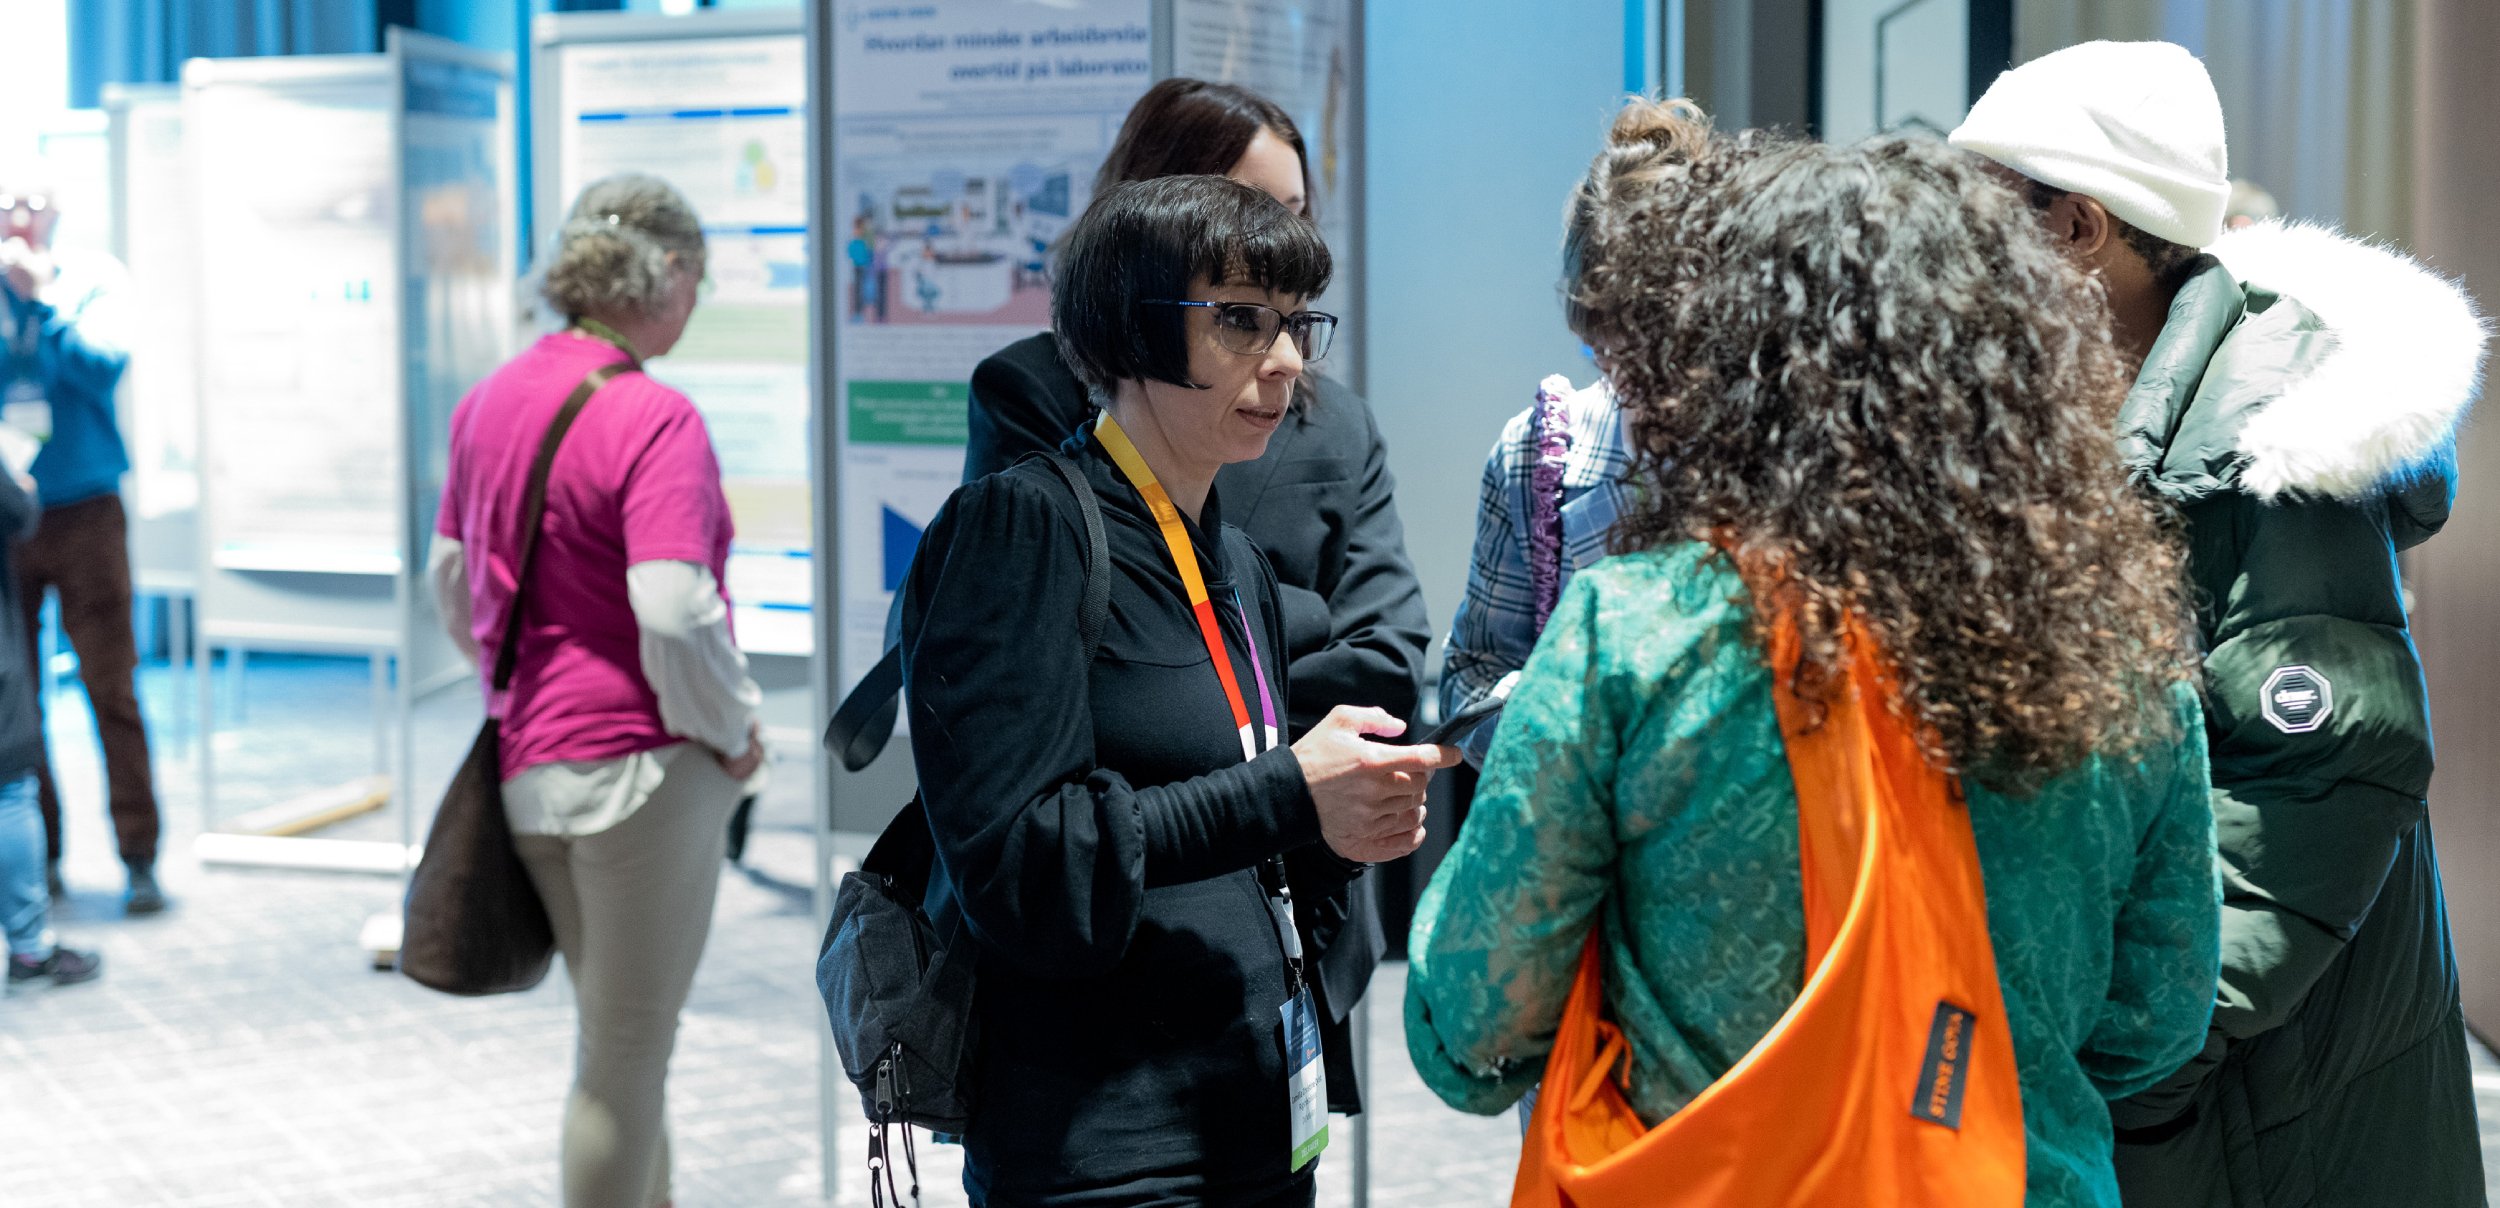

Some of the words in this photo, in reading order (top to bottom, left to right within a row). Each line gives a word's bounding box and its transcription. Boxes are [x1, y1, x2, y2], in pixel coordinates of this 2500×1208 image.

[864, 32, 945, 51] Hvordan
[953, 29, 1022, 47] minske
[950, 61, 1020, 80] overtid
